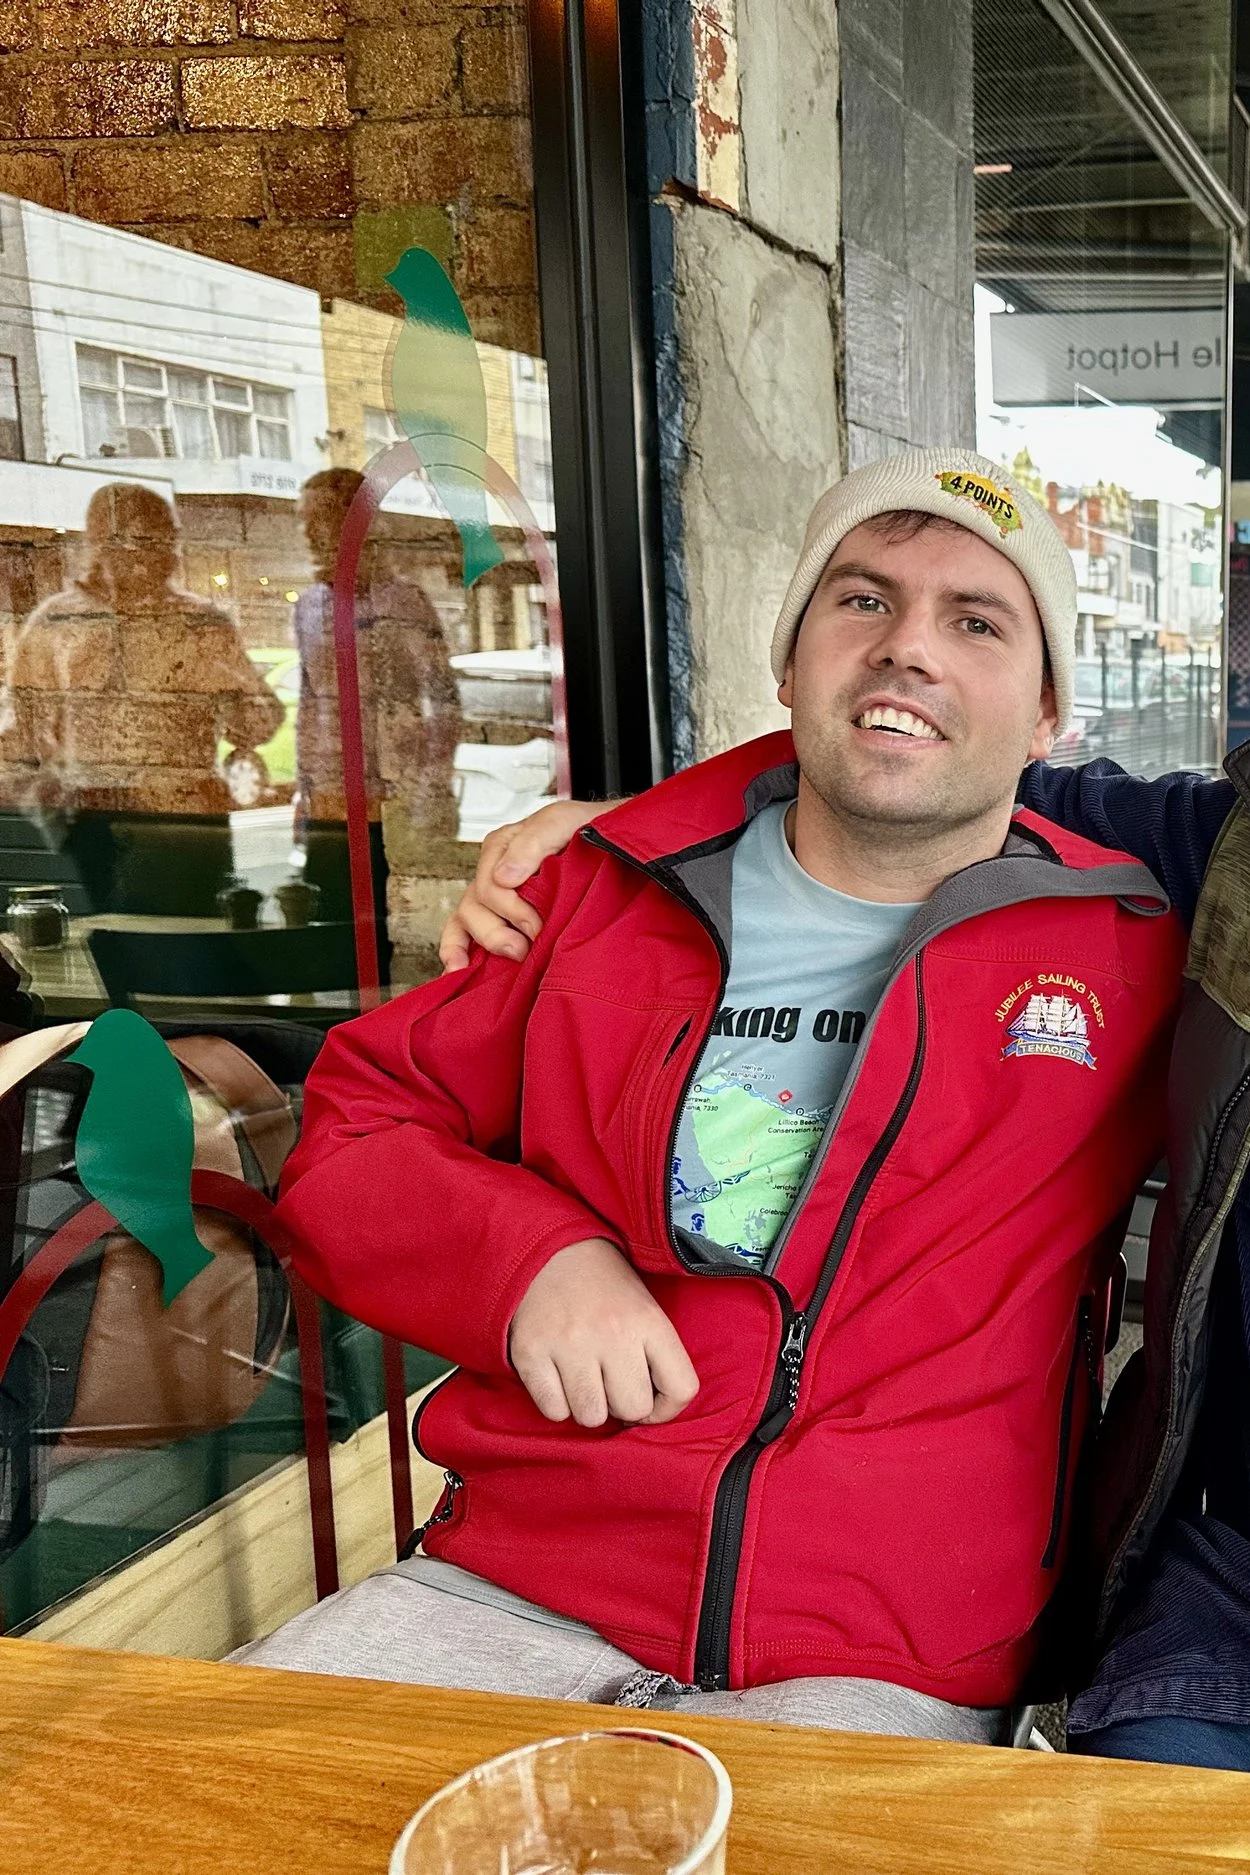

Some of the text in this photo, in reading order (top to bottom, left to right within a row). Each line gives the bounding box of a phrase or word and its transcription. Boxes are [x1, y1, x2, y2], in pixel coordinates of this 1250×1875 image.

[950, 475, 1014, 519] 4 POINTS
[994, 973, 1105, 1029] JUBILEE SAILING TRUST
[1019, 1044, 1083, 1062] TENACIOUS
